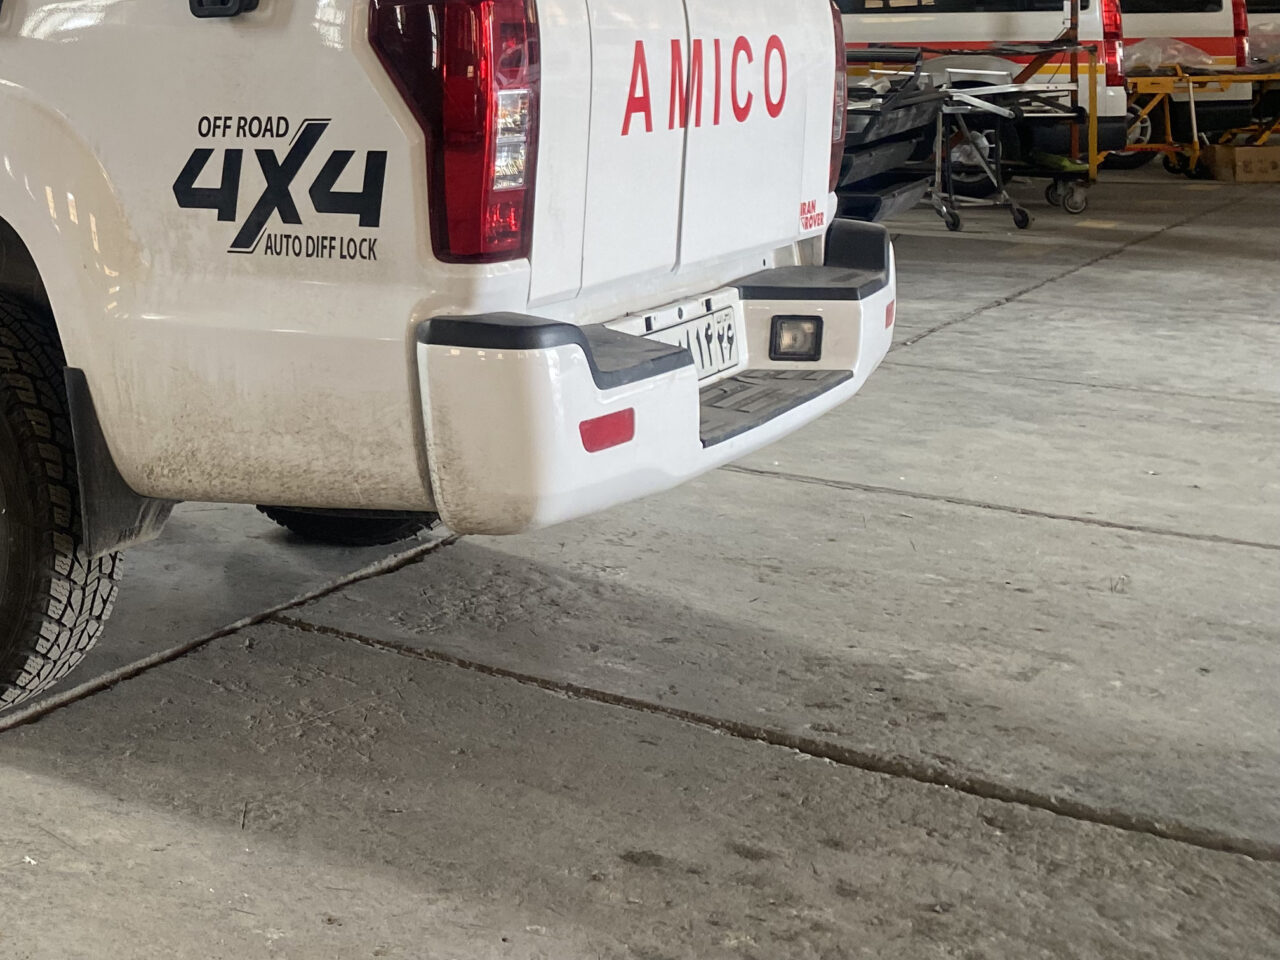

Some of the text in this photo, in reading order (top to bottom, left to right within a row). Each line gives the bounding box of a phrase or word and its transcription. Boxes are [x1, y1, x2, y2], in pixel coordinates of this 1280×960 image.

[621, 34, 787, 136] AMICO
[198, 116, 290, 139] OFF ROAD
[172, 119, 388, 252] 4X4
[800, 199, 816, 217] IRAN
[264, 234, 378, 261] AUTO DIFF LOCK
